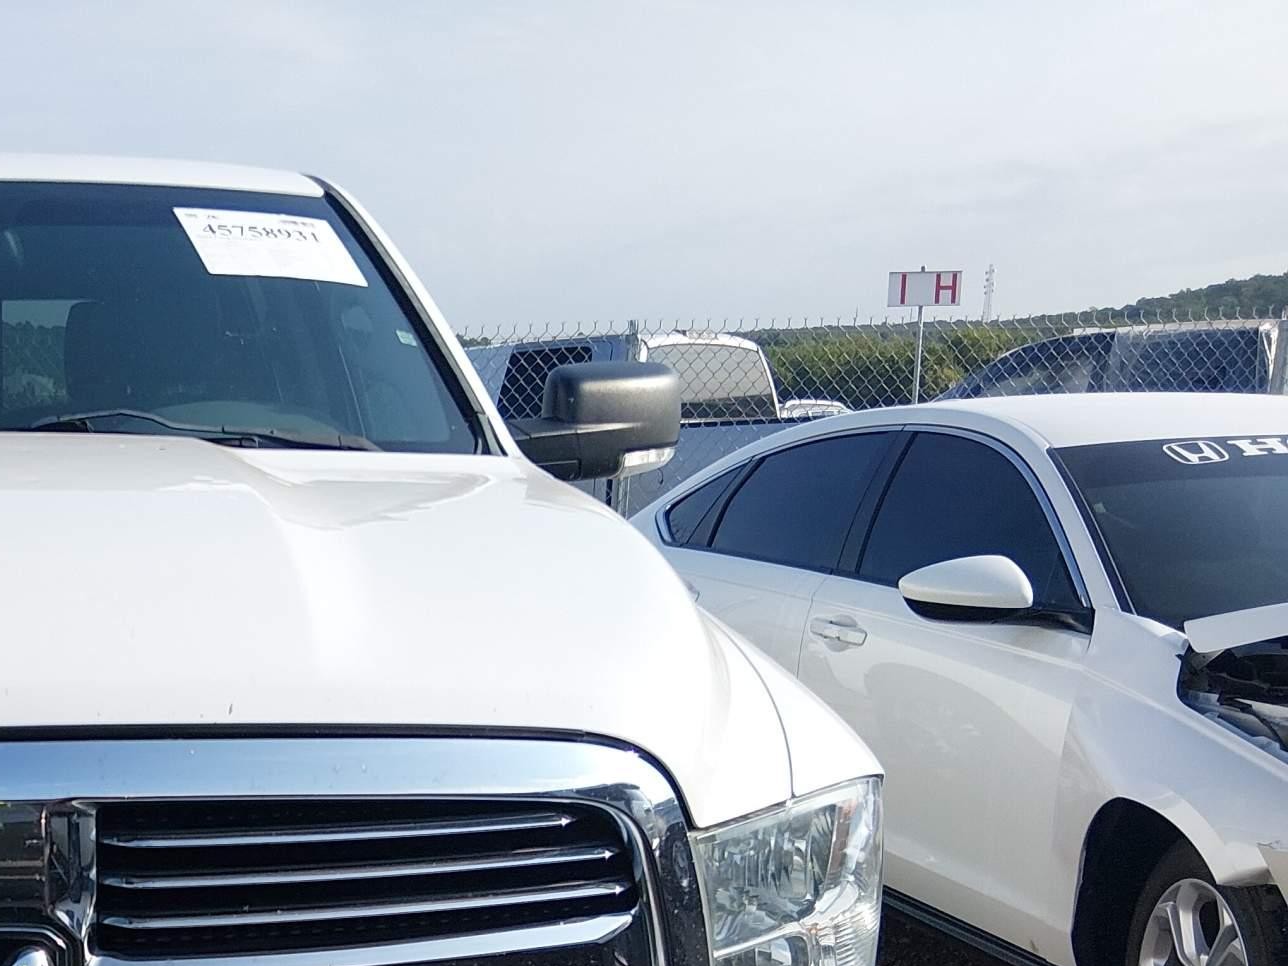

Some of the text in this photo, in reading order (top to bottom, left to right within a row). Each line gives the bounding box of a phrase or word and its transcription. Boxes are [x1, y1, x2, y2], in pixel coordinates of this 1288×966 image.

[202, 223, 320, 242] 45758931
[934, 273, 958, 305] H
[1226, 437, 1288, 456] H
